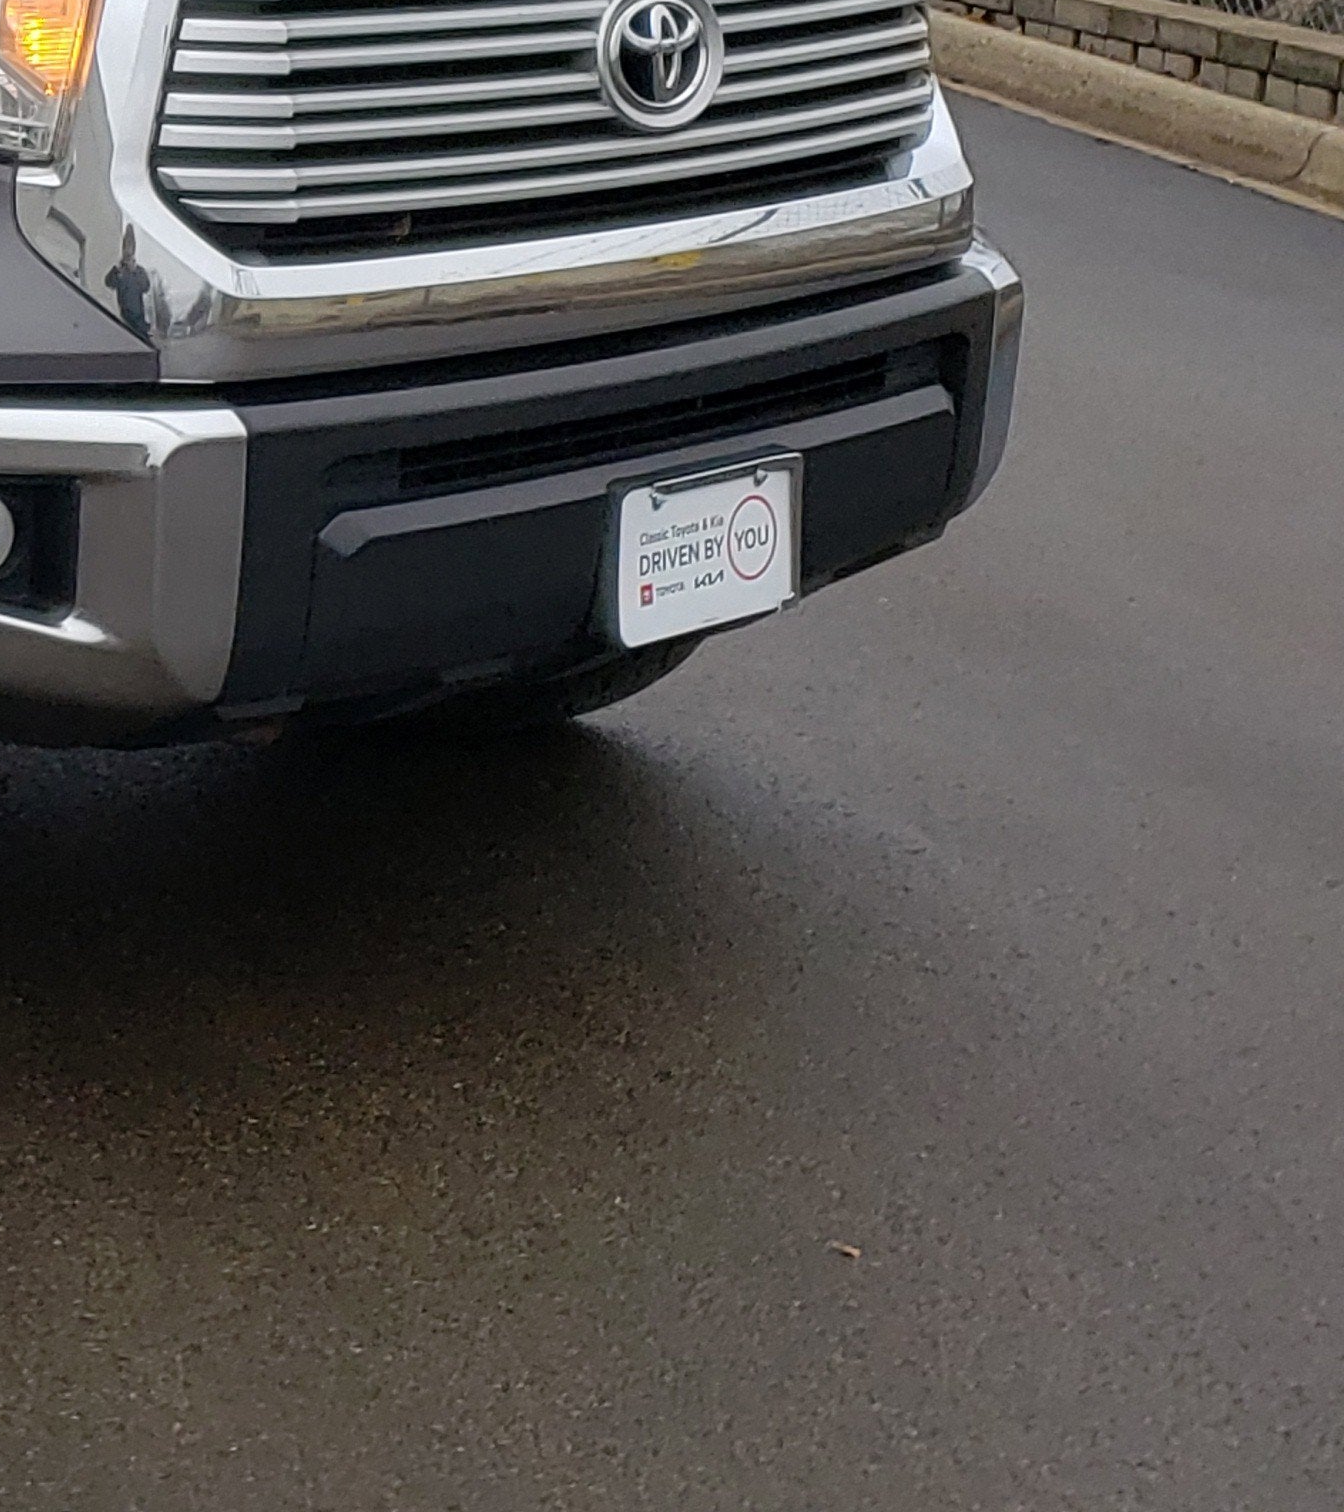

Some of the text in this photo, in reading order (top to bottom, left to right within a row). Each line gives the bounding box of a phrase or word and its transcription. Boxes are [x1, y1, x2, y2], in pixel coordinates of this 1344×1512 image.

[670, 522, 700, 539] Toyota
[639, 524, 769, 577] DRIVEN BY YOU
